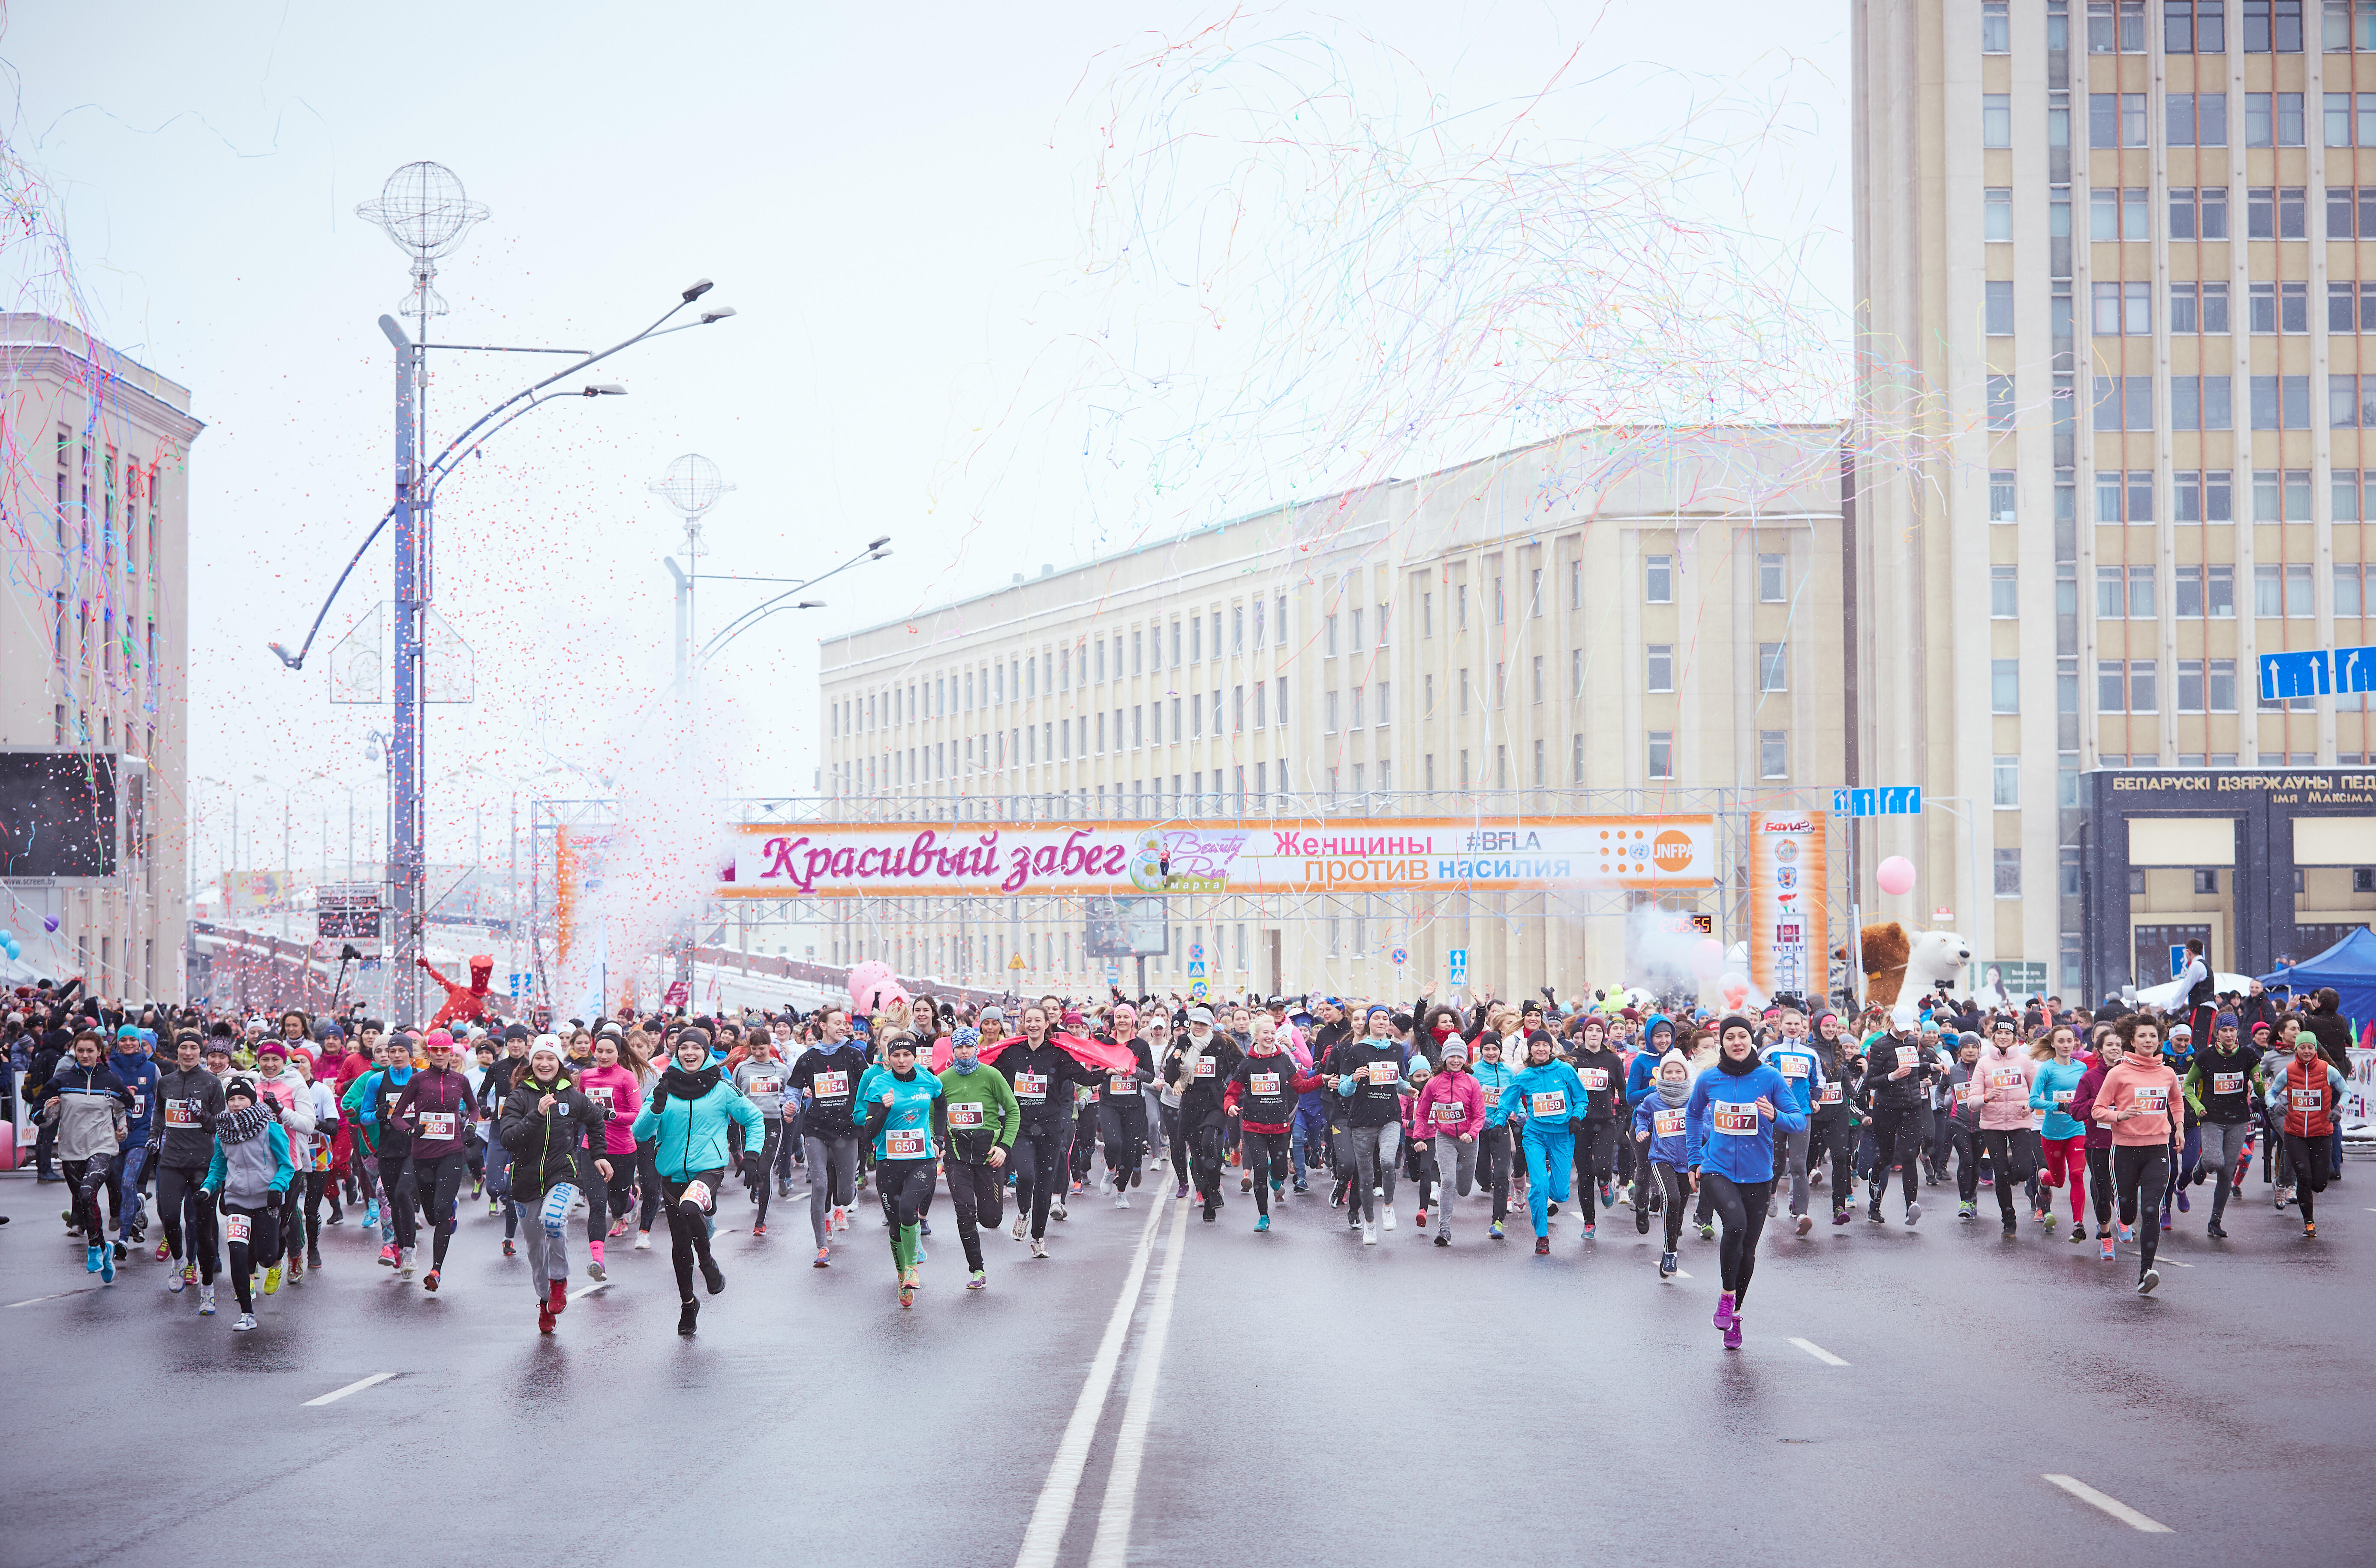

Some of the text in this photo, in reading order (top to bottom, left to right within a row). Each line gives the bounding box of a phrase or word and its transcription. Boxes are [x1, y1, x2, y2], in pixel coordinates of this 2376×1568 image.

[1273, 831, 1432, 859] Женщины
[1466, 831, 1543, 851] #BFLA
[1163, 831, 1246, 865] Beauty
[1653, 843, 1694, 859] UNFPA
[759, 827, 1127, 894] Красивый забег
[1170, 855, 1230, 880] Run
[1305, 859, 1570, 890] против насилия
[3, 877, 56, 887] www.screen.by
[1170, 881, 1220, 891] марта
[1997, 1021, 2015, 1032] VOGUE
[1899, 1054, 1919, 1063] 88888
[1194, 1065, 1212, 1073] 159
[1785, 1063, 1807, 1072] 1259
[1374, 1071, 1396, 1080] 2157
[1997, 1075, 2019, 1086] 1477
[819, 1080, 844, 1092] 2154
[1254, 1082, 1276, 1091] 2169
[1581, 1077, 1604, 1086] 2010
[2219, 1080, 2240, 1090] 1537
[756, 1083, 772, 1092] 841
[1021, 1083, 1040, 1093] 134
[911, 1092, 931, 1101] vplab
[1822, 1090, 1840, 1100] 1767
[1537, 1100, 1561, 1111] 1159
[2139, 1098, 2164, 1109] 2777
[2298, 1098, 2315, 1106] 918
[172, 1111, 191, 1122] 761
[955, 1113, 975, 1123] 963
[1440, 1111, 1462, 1119] 1868
[1659, 1117, 1686, 1131] 1878
[1719, 1115, 1752, 1128] 1017
[427, 1123, 447, 1133] 266
[895, 1141, 917, 1152] 650
[685, 1189, 709, 1207] 1431
[228, 1225, 248, 1237] 555
